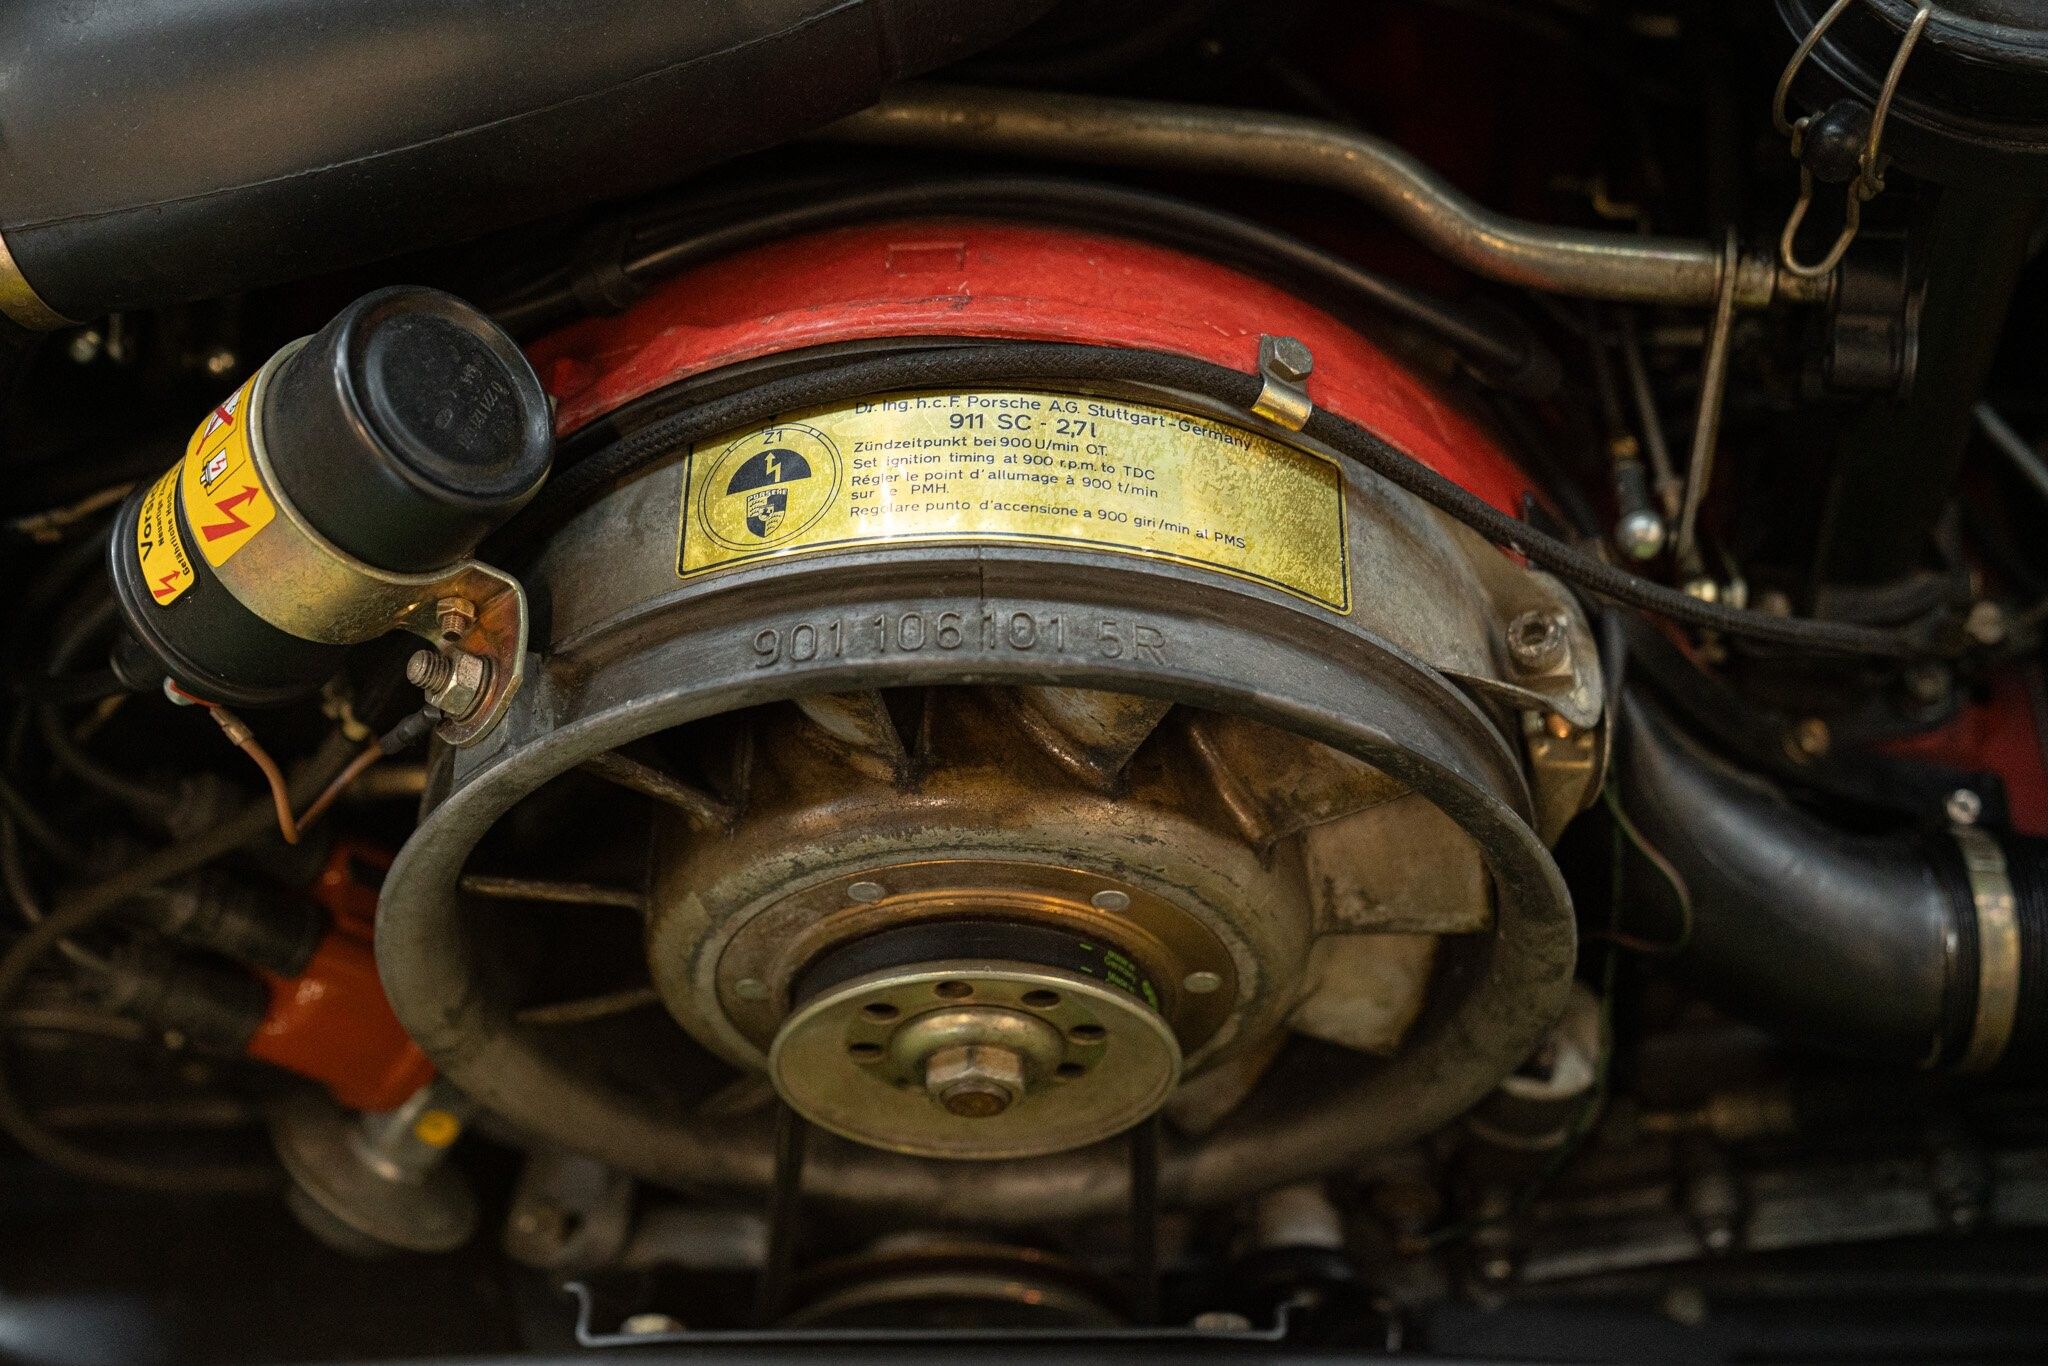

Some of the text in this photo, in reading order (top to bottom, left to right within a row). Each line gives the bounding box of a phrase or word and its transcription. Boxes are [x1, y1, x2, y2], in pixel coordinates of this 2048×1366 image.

[855, 402, 878, 414] Dr.
[968, 395, 1041, 410] Porsche
[1049, 400, 1080, 413] A.G.
[950, 413, 985, 429] 911
[997, 413, 1032, 430] SC
[763, 430, 783, 444] Z1
[853, 436, 1108, 456] Zündzeitpunkt bei 900 U/min O.T.
[853, 452, 1156, 481] Set ignition timing at 900 r.p.m. to TDC
[851, 473, 900, 486] Régler
[906, 471, 919, 482] le
[924, 469, 963, 482] point
[1066, 475, 1075, 485] à
[1082, 477, 1112, 490] 900
[1118, 482, 1159, 498] t/min
[851, 490, 876, 500] sur
[911, 483, 950, 495] PMH.
[925, 500, 970, 513] punto
[979, 500, 1079, 516] d'accensione
[1083, 509, 1092, 518] a
[1097, 509, 1128, 523] 900
[1133, 516, 1190, 535] giri/min
[1196, 528, 1208, 540] al
[1214, 531, 1246, 549] PMS
[752, 617, 844, 669] 901
[873, 611, 965, 652] 106
[980, 608, 1067, 652] 101
